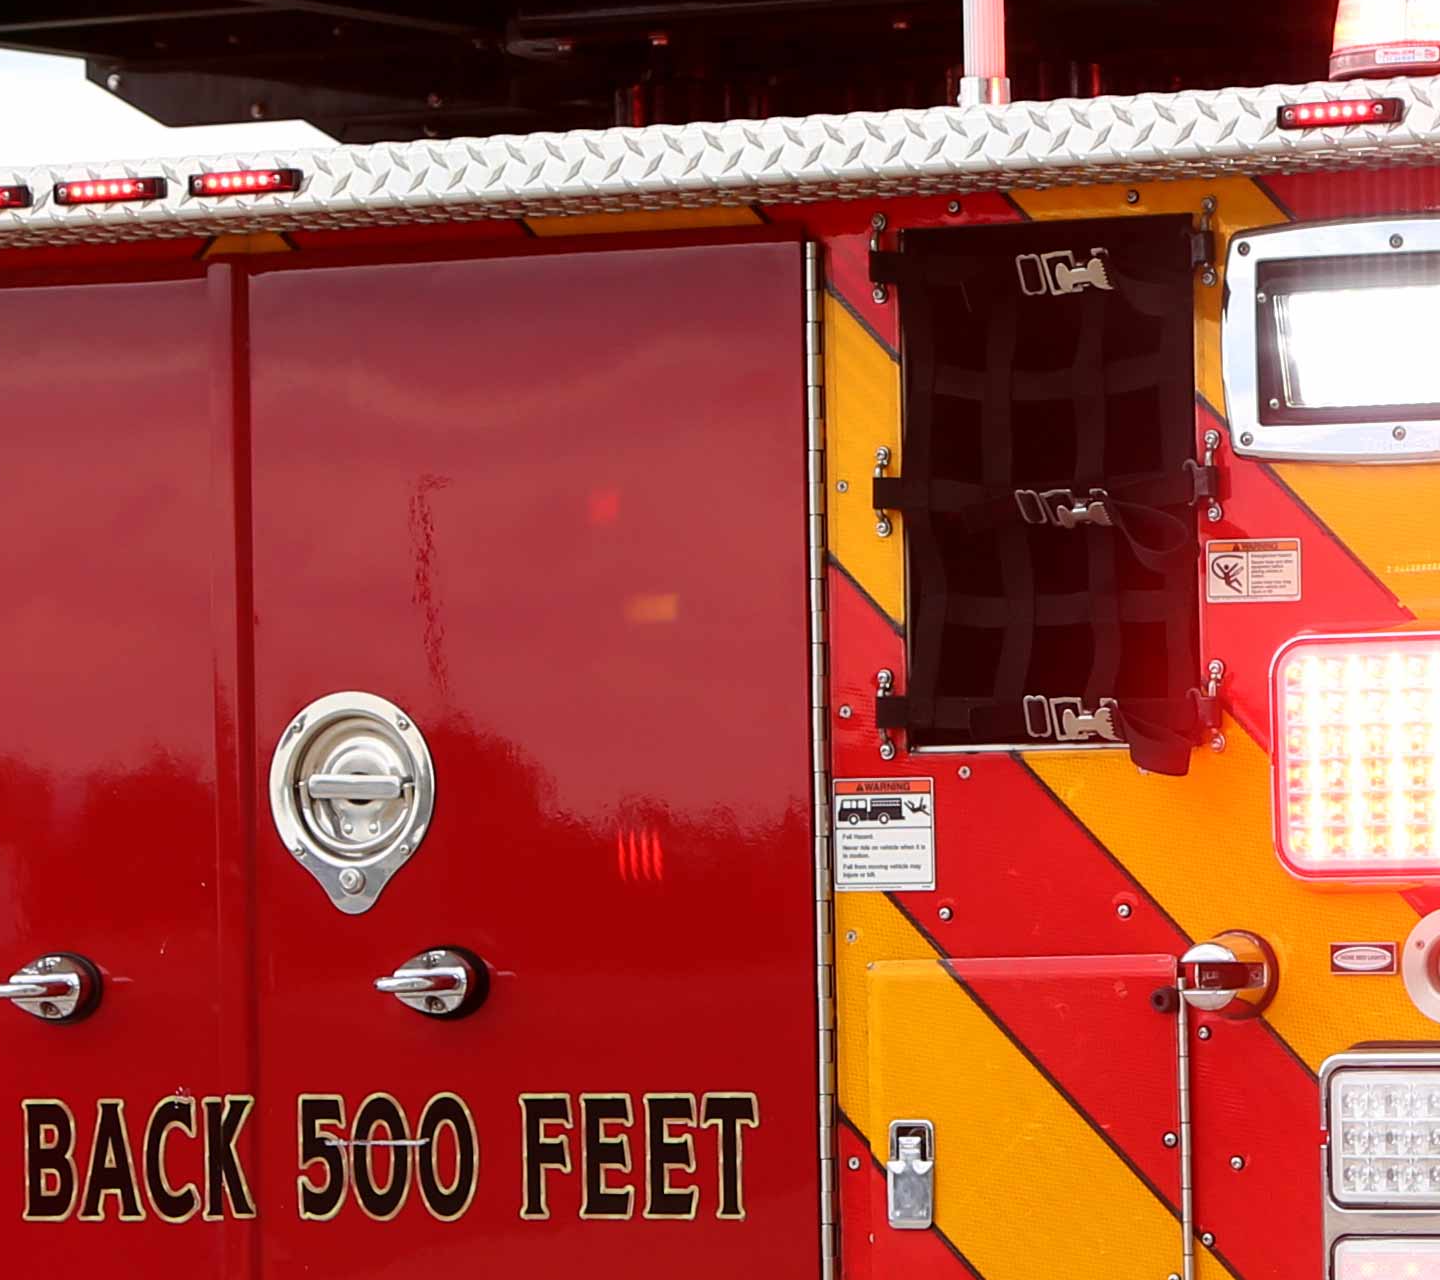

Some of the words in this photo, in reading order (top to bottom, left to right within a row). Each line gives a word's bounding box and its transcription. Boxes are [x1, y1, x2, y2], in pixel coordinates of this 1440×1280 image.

[864, 782, 911, 791] WARNING
[20, 1094, 256, 1221] BACK
[296, 1091, 480, 1221] 500
[518, 1091, 760, 1221] FEET
